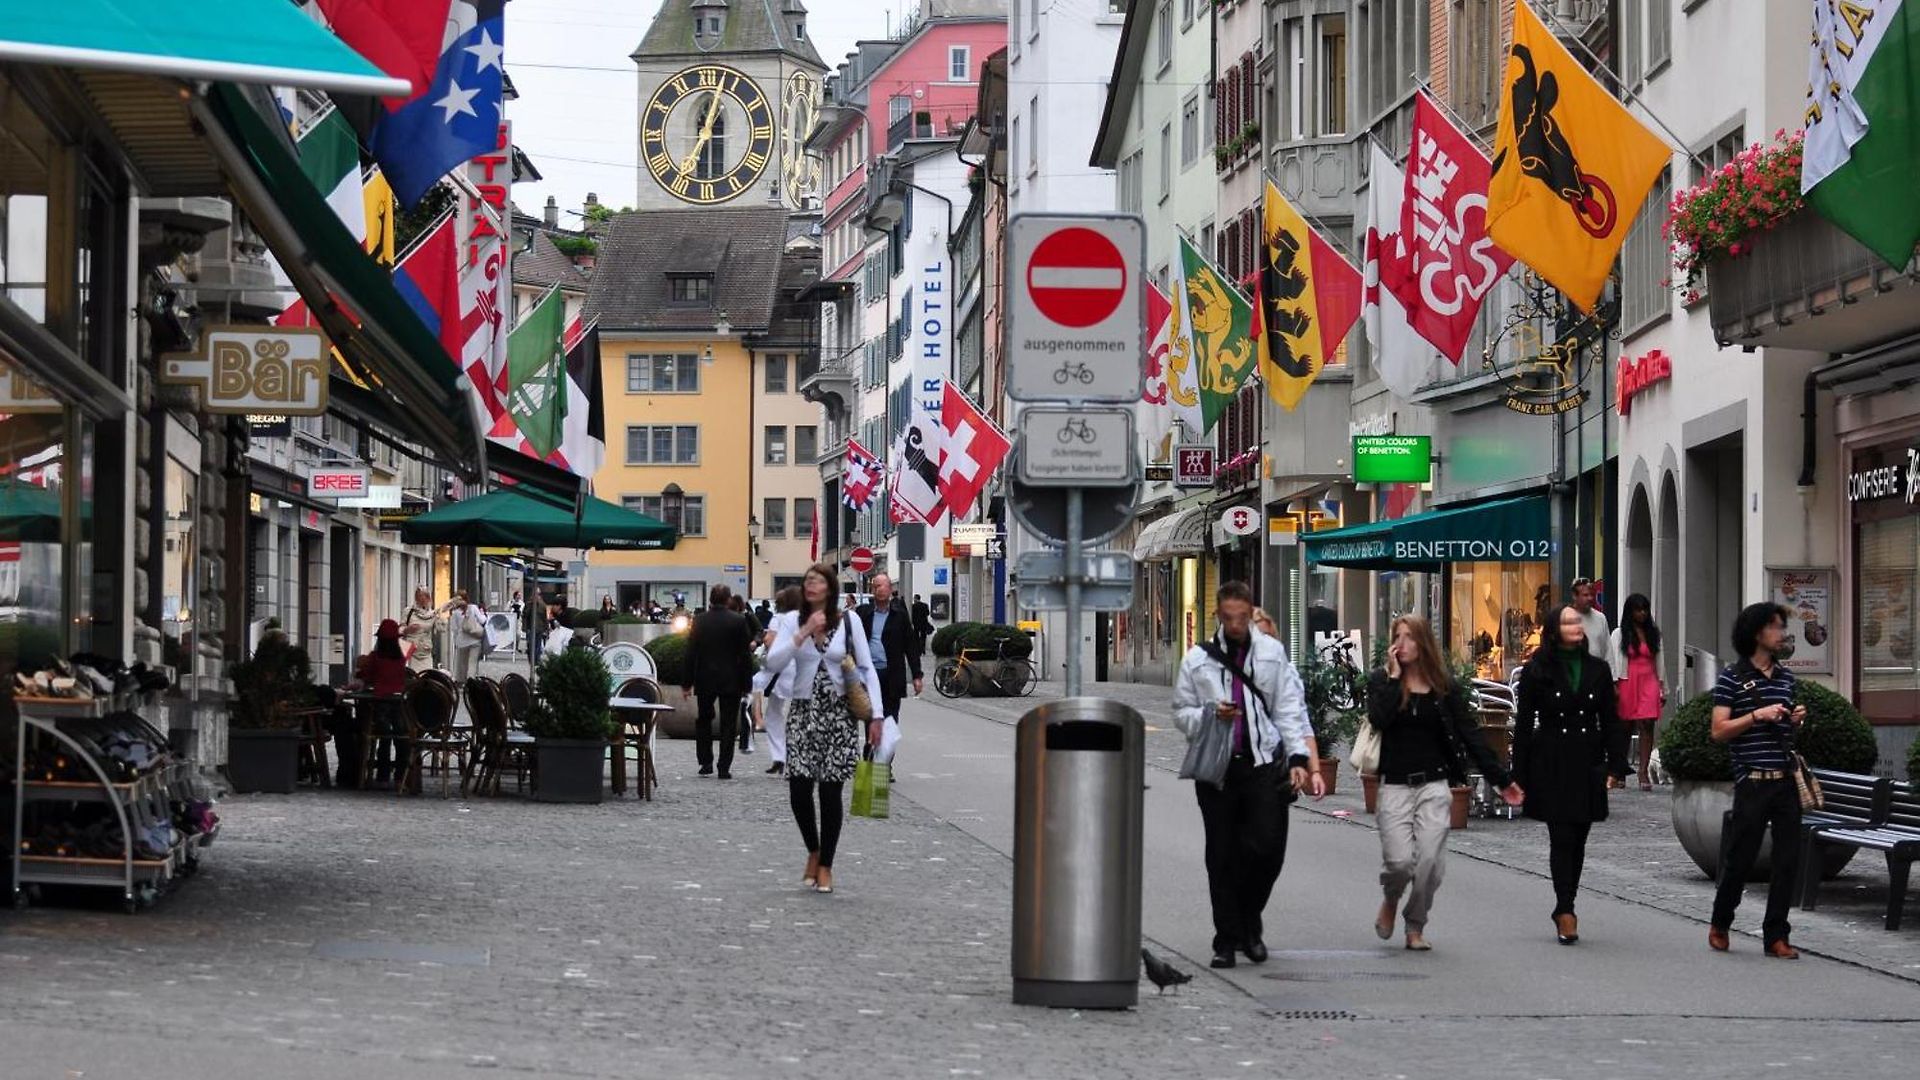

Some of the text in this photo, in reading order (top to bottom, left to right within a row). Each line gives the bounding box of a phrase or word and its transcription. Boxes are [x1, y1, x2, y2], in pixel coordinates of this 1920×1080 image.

[699, 69, 717, 86] XII
[924, 262, 941, 357] HOTEL
[1024, 339, 1125, 353] ausgenommen
[212, 339, 320, 401] Bär
[1506, 397, 1533, 414] FRANZ
[1557, 393, 1583, 412] WEBER
[1357, 438, 1418, 446] UNITED COLORS
[1357, 447, 1368, 455] OF
[313, 474, 362, 490] BREE
[1847, 466, 1898, 501] CONFISERIE
[988, 541, 1002, 553] K
[1395, 540, 1502, 558] BENETTON
